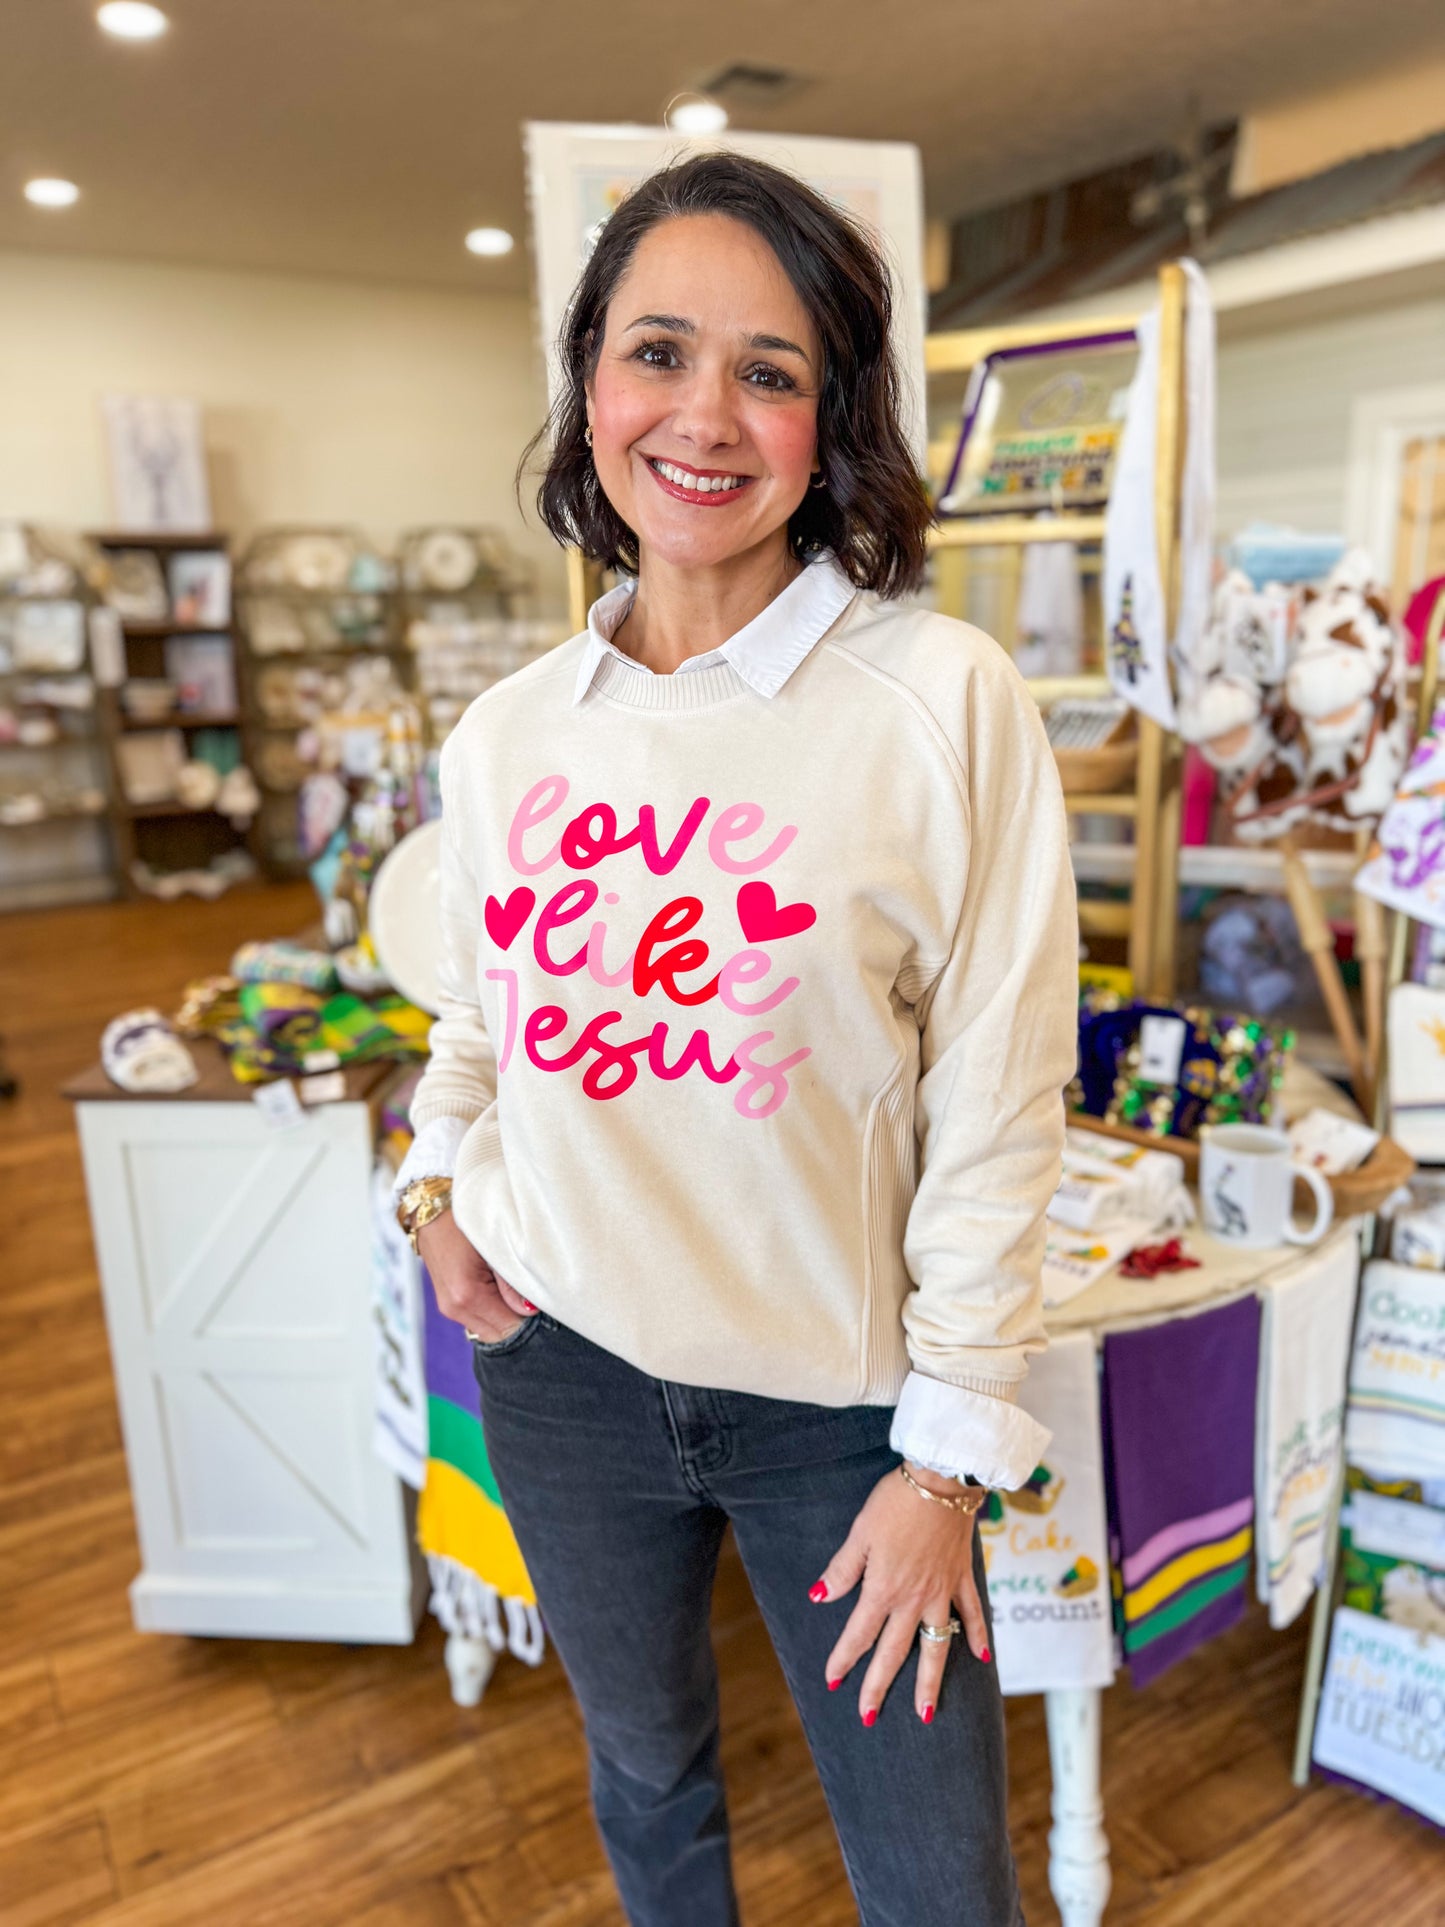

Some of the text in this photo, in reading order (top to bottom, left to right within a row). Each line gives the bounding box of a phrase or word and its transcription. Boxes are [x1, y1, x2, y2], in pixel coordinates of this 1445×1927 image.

[507, 774, 799, 876] love
[533, 879, 800, 1016] like
[485, 968, 813, 1120] Jesus
[1009, 1519, 1076, 1557] Cake
[1010, 1601, 1101, 1623] count
